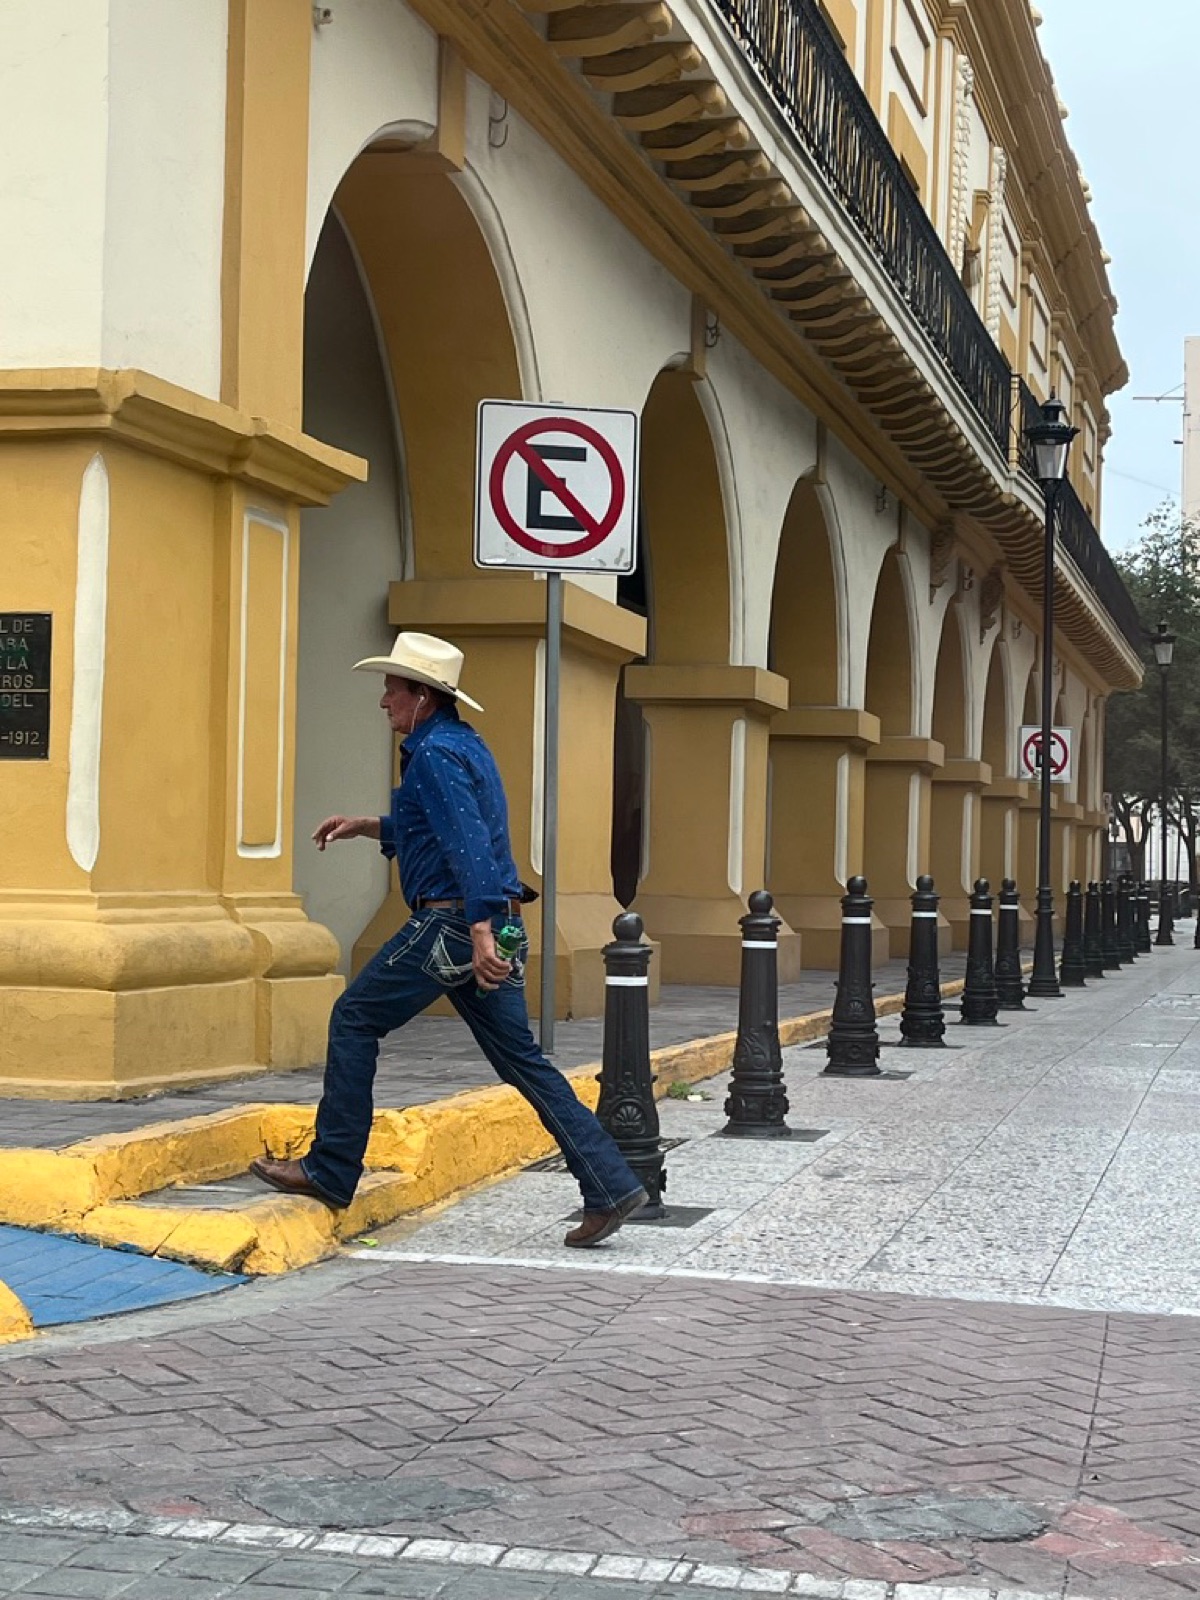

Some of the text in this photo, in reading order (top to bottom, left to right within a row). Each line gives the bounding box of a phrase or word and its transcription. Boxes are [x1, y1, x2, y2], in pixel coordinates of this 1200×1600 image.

[13, 619, 34, 633] DE
[7, 656, 28, 670] LA
[2, 674, 34, 689] ROS
[2, 693, 34, 707] DEL
